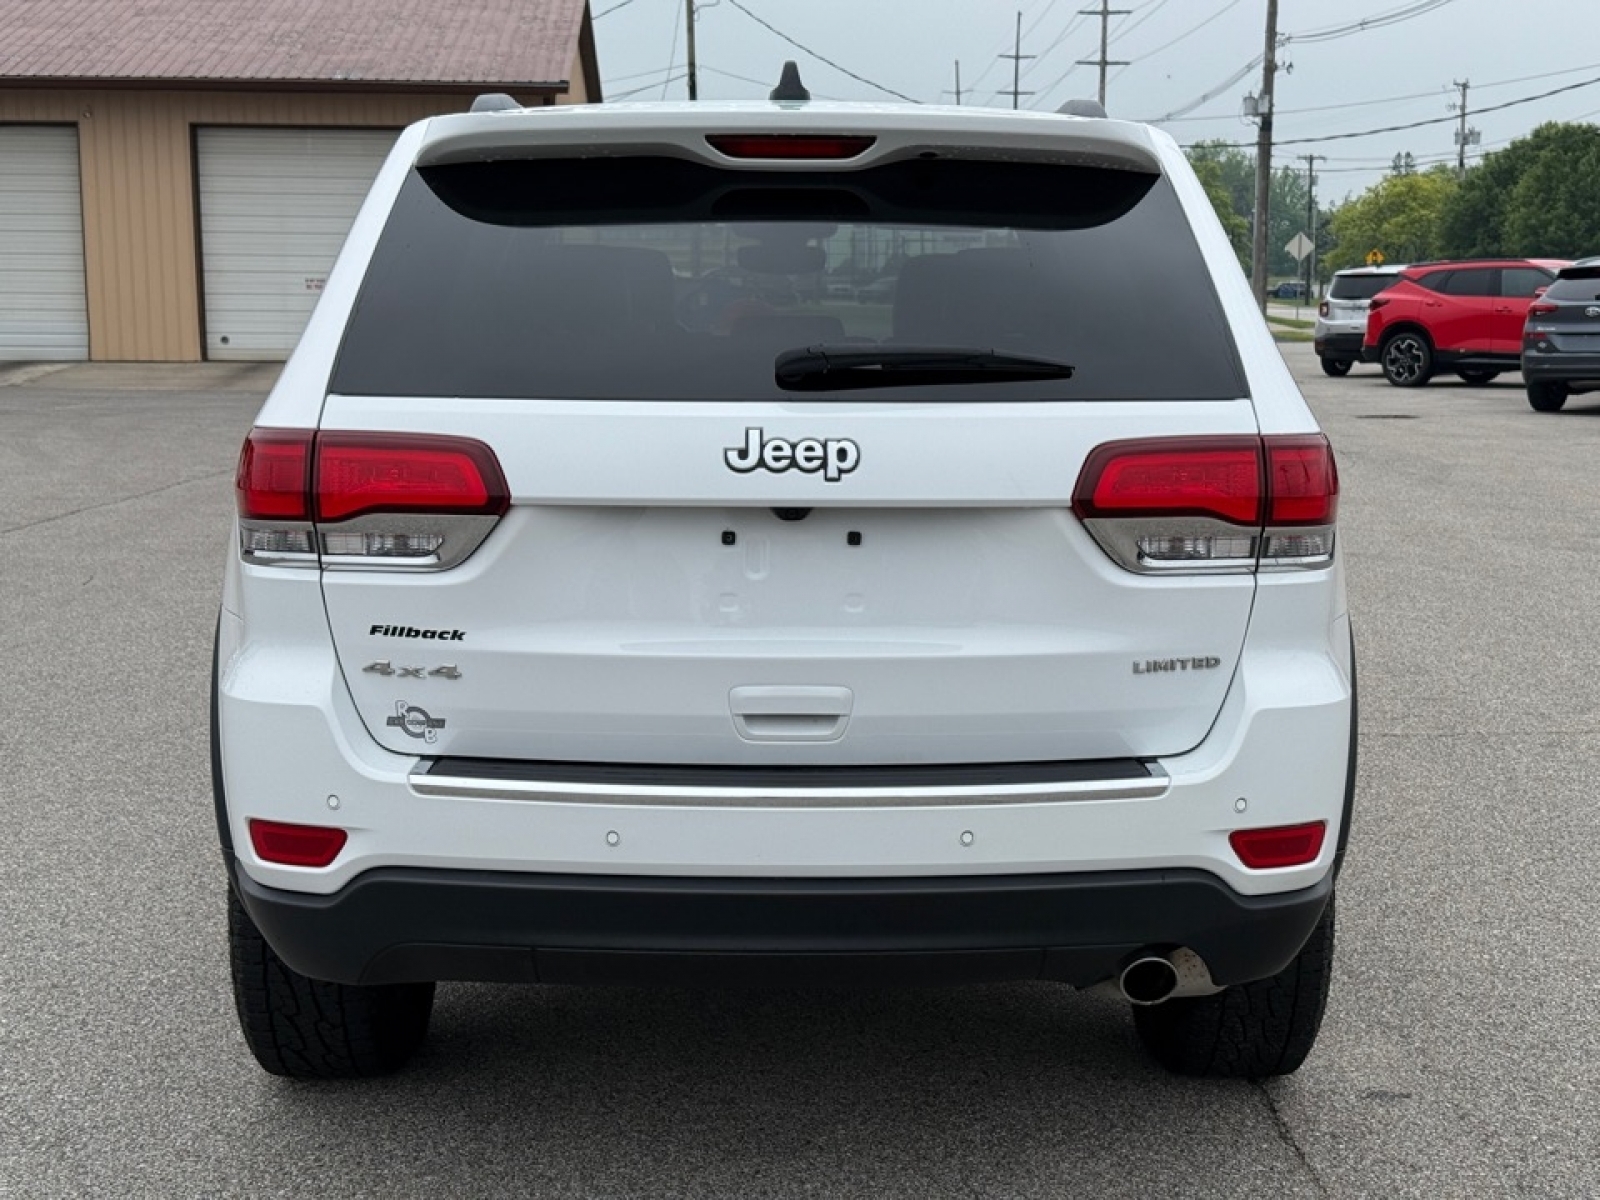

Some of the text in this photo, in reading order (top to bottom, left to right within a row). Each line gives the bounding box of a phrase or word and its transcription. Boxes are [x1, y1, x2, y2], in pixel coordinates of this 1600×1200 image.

[723, 427, 860, 482] Jeep
[369, 624, 467, 641] Fillback
[362, 660, 462, 680] 4x4
[1132, 656, 1221, 675] LIMITED
